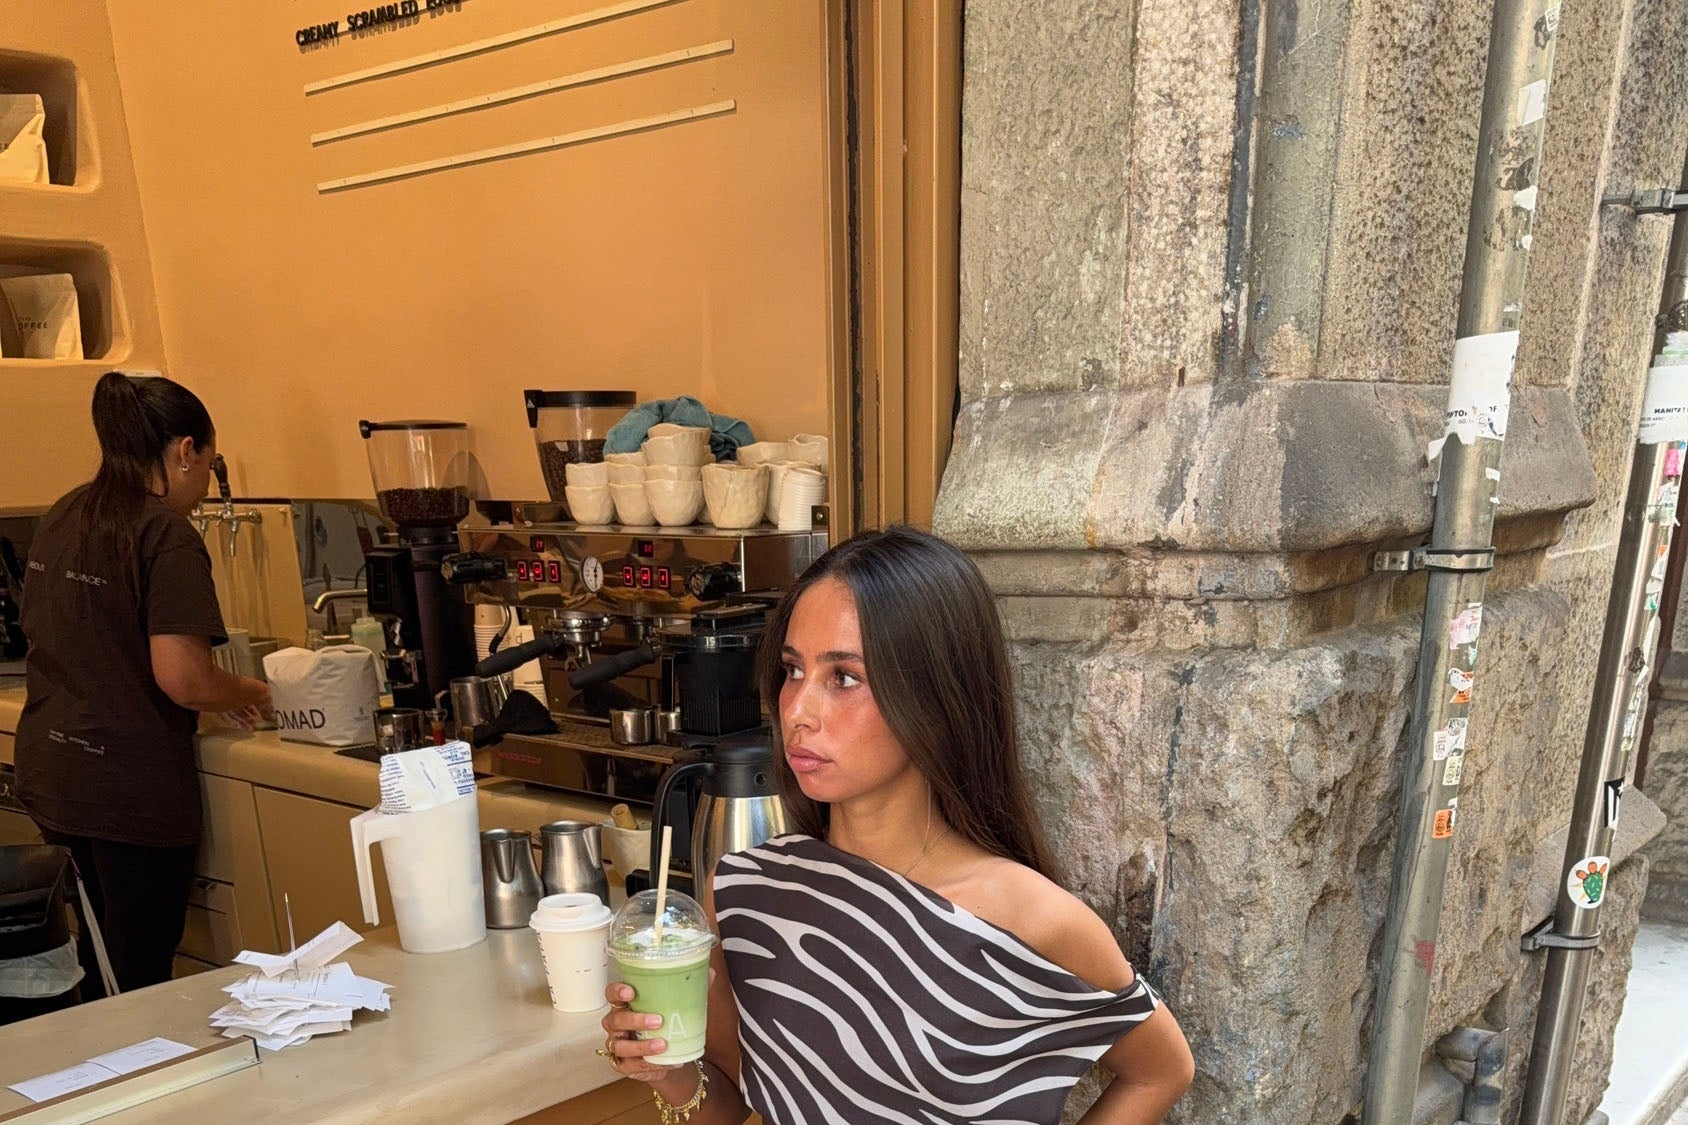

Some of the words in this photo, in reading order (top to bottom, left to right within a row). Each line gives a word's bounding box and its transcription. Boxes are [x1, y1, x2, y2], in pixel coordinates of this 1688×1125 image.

[296, 21, 339, 46] CREAMY
[347, 0, 419, 31] SCRAMBLED
[17, 321, 48, 330] OFFEE
[275, 708, 326, 730] OMAD
